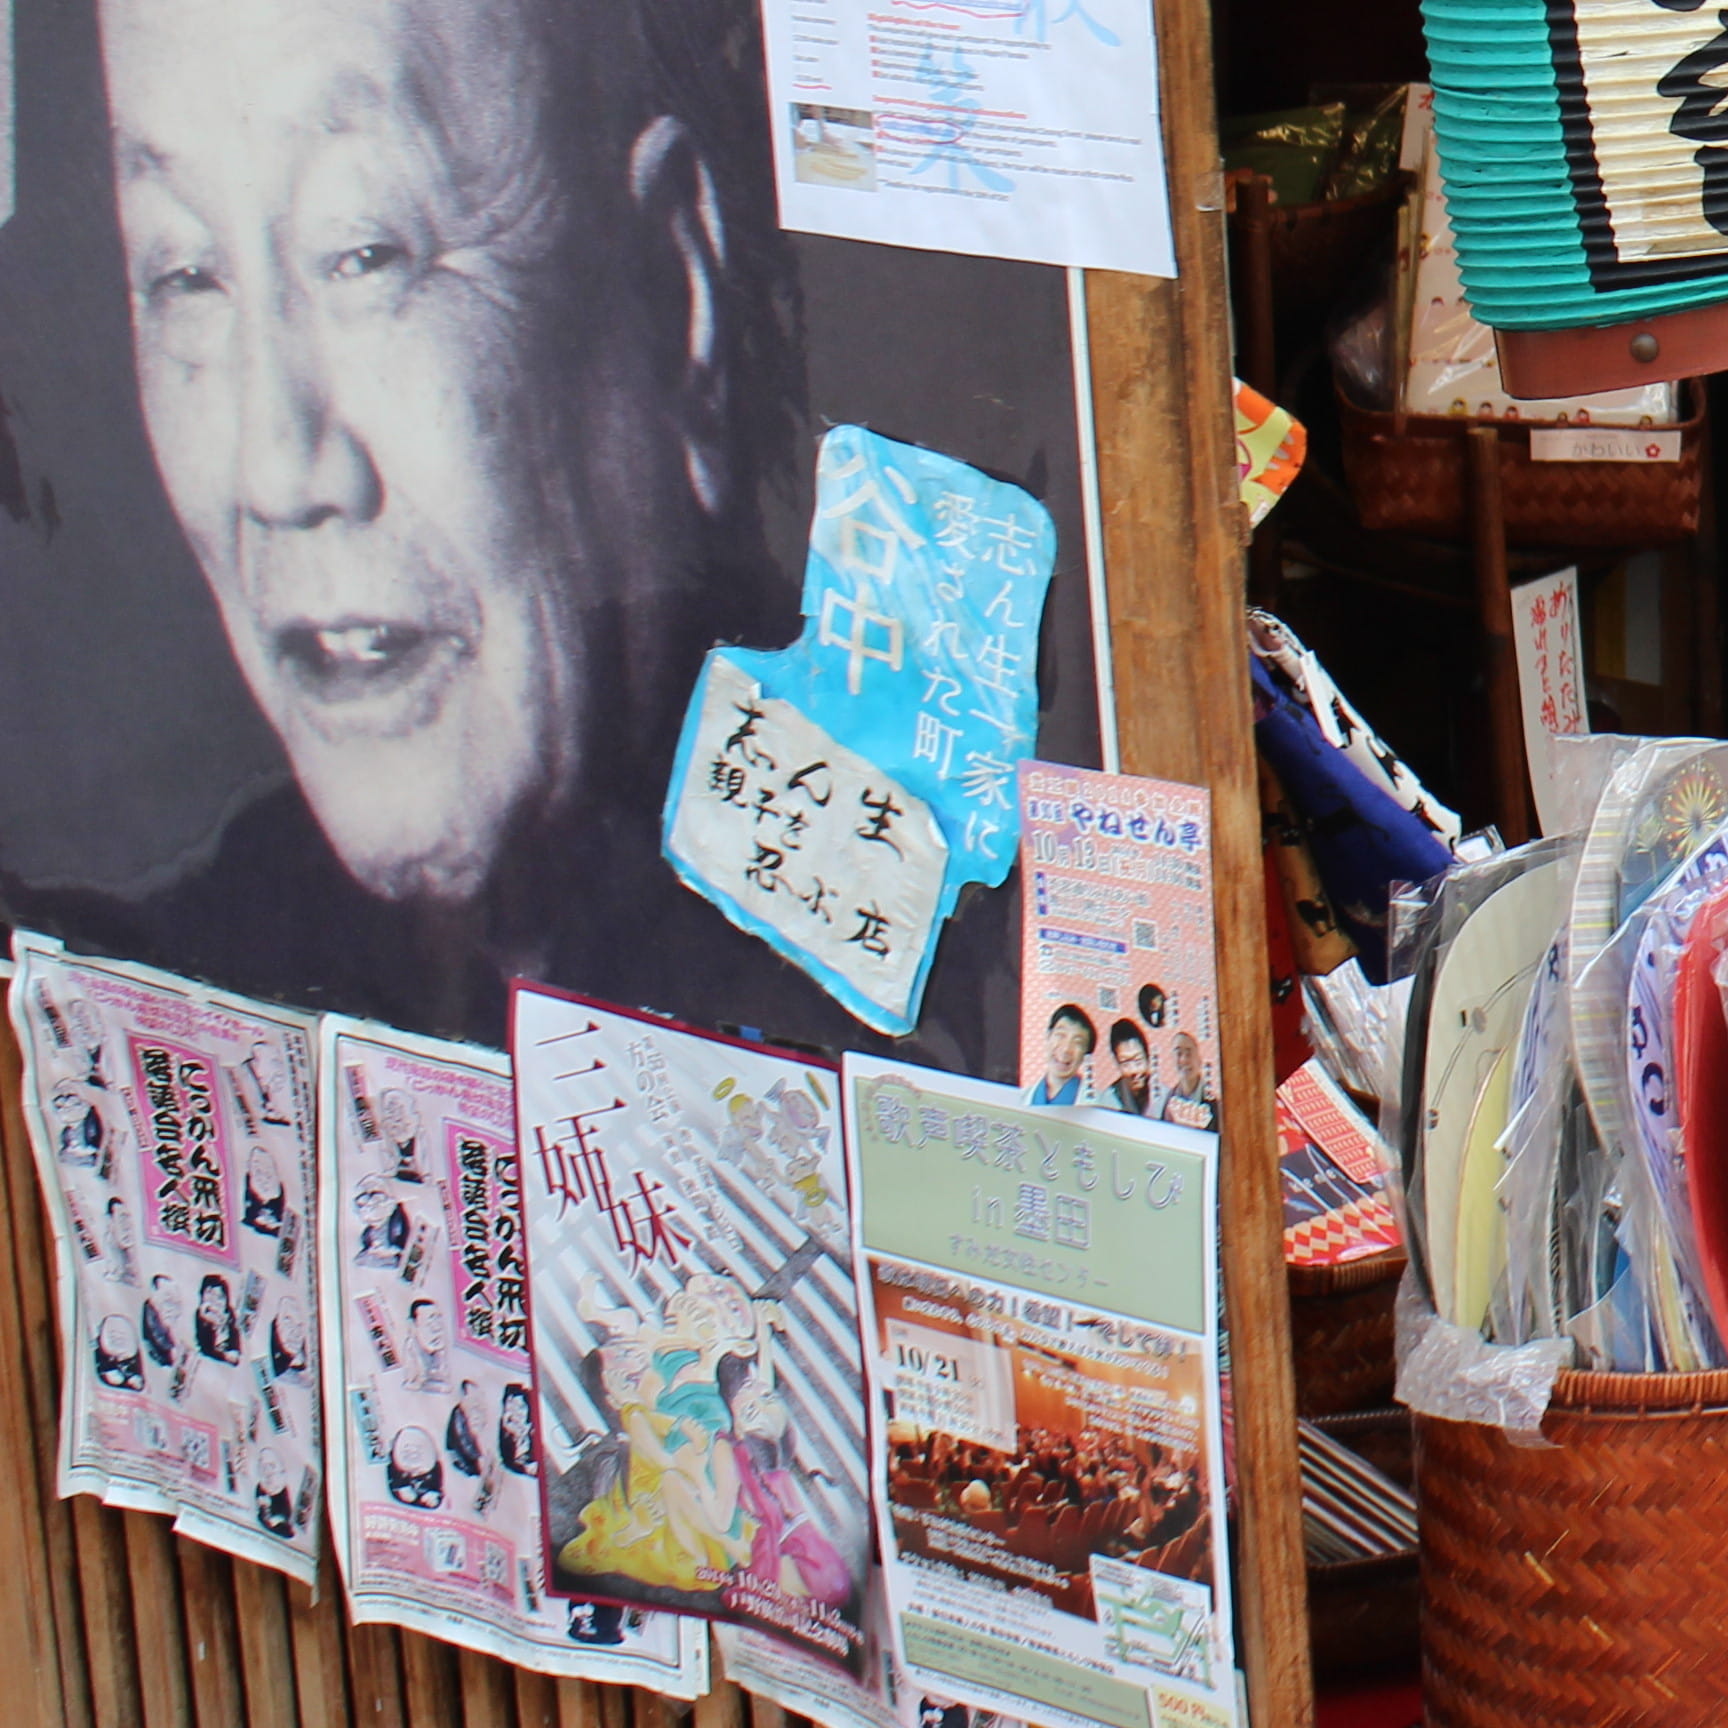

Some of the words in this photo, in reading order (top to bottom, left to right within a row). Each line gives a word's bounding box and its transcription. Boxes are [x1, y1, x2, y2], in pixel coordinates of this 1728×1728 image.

[818, 454, 925, 695] 谷中
[912, 489, 981, 779] 愛された町
[710, 759, 812, 851] 親子を
[726, 703, 905, 862] 志ん生
[746, 845, 891, 960] 忍ぶ店
[532, 1020, 694, 1280] 三姉妹
[873, 1092, 1186, 1210] 歌声喫茶ともしび
[970, 1186, 1006, 1228] in
[1012, 1182, 1092, 1250] 墨田
[897, 1342, 959, 1382] 10/21
